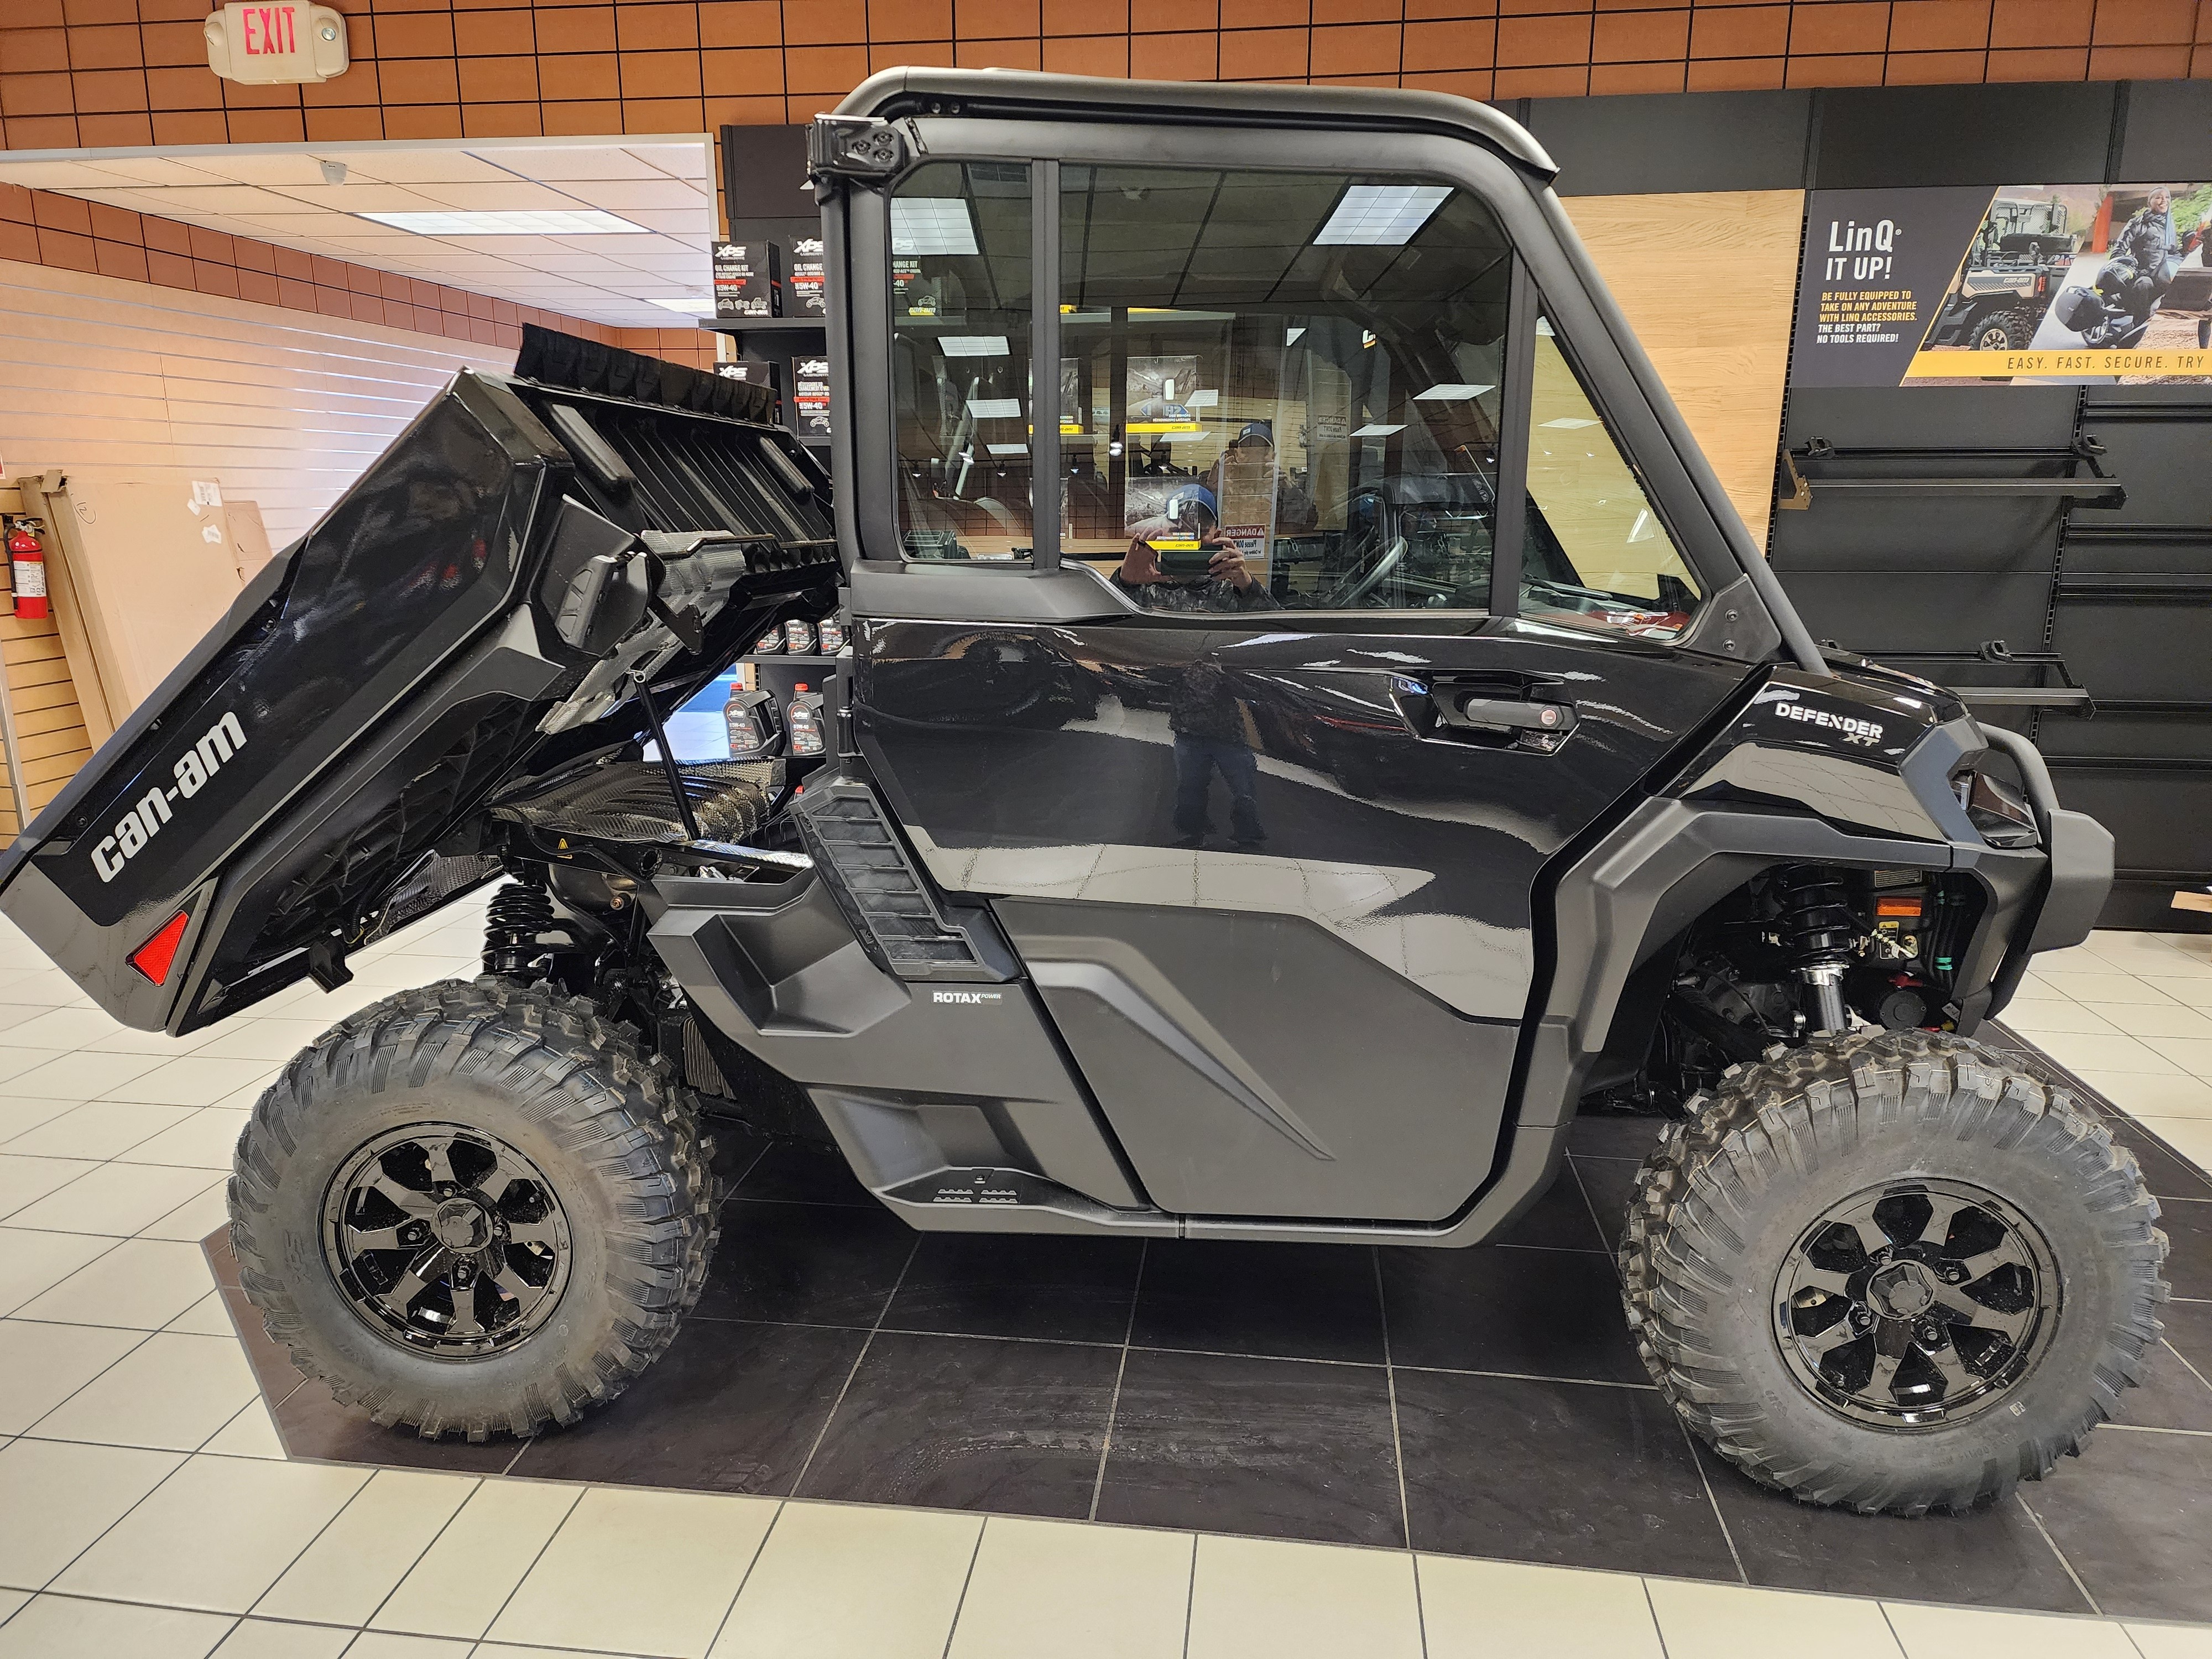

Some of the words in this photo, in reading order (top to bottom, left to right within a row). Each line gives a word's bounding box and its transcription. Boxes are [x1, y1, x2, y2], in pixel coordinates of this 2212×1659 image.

[243, 7, 295, 54] EXIT
[715, 244, 747, 257] XPS
[794, 239, 823, 253] XPS
[892, 238, 914, 251] PS
[1826, 258, 1847, 280] IT
[1854, 257, 1892, 280] UP!
[1822, 292, 1832, 301] BE
[1834, 292, 1858, 300] FULLY
[1860, 291, 1899, 300] EQUIPPED
[1902, 291, 1911, 299] TO
[1821, 303, 1839, 311] TAKE
[1841, 302, 1852, 311] ON
[1854, 302, 1870, 311] ANY
[1871, 301, 1917, 310] ADVENTURE
[1819, 314, 1839, 322] WITH
[1841, 313, 1859, 322] LINQ
[1861, 312, 1917, 321] ACCESSORIES.
[1818, 324, 1832, 333] THE
[1834, 324, 1854, 332] BEST
[1856, 324, 1881, 332] PART?
[1817, 335, 1828, 343] NO
[1830, 335, 1854, 343] TOOLS
[1856, 333, 1898, 342] REQUIRED!
[797, 360, 828, 373] XPS
[2007, 357, 2047, 369] EASY.
[2057, 357, 2095, 369] FAST.
[2105, 356, 2168, 368] SECURE.
[2177, 356, 2204, 368] TRY
[719, 366, 748, 378] XPS
[1775, 702, 1884, 739] DEFENDER
[1843, 733, 1880, 747] XT
[91, 711, 247, 883] can-am
[933, 993, 981, 1004] ROTAX
